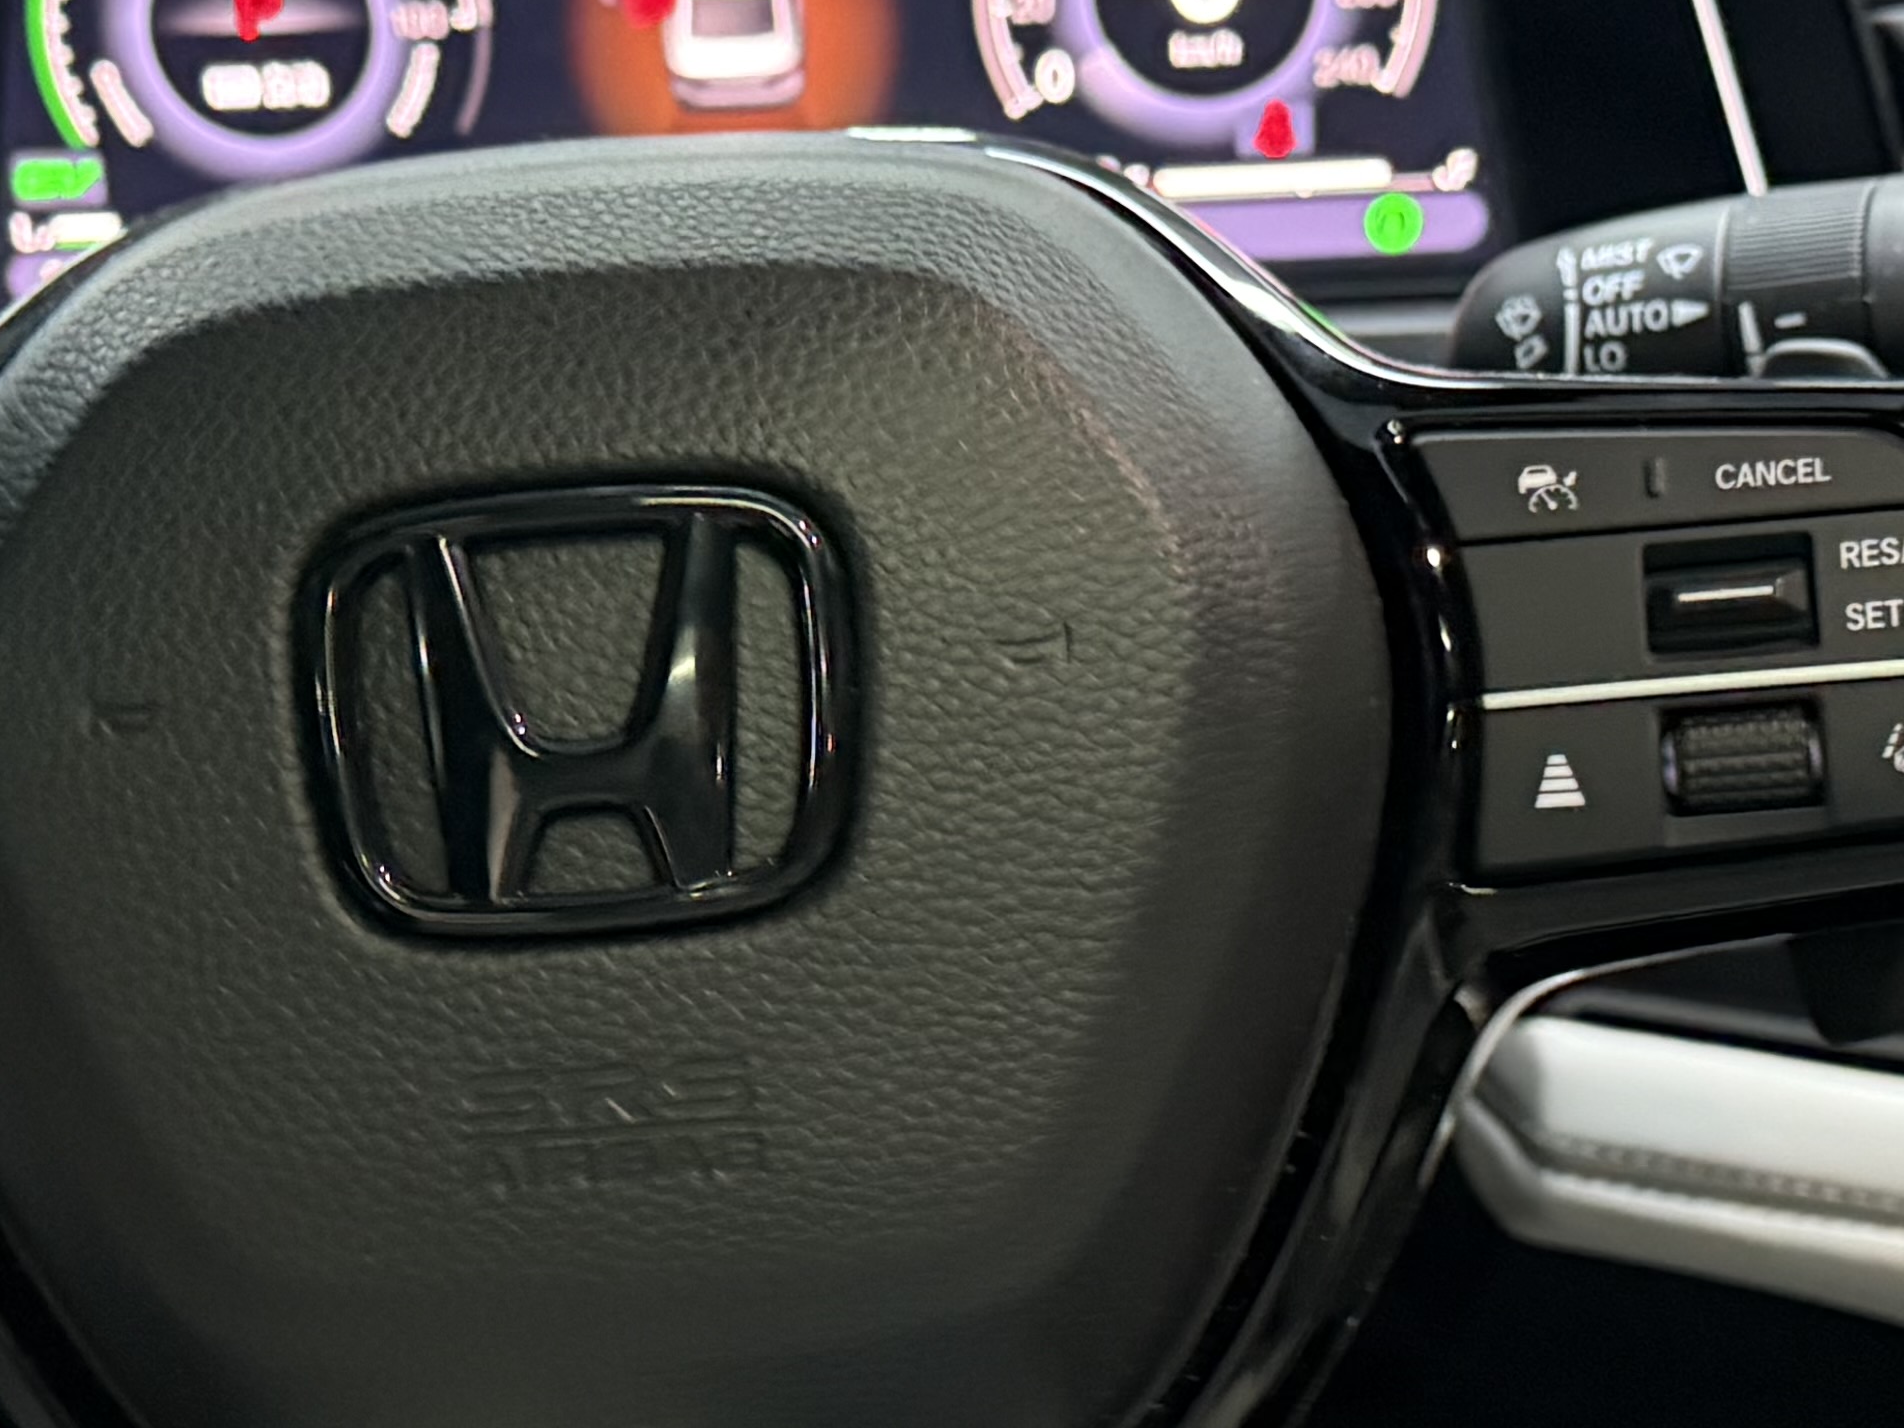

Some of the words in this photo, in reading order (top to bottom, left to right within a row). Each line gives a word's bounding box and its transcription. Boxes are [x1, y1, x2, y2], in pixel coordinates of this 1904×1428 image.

[1582, 268, 1645, 306] OFF
[1584, 298, 1669, 339] AUTO
[1583, 340, 1627, 372] LO
[1714, 457, 1832, 491] CANCEL
